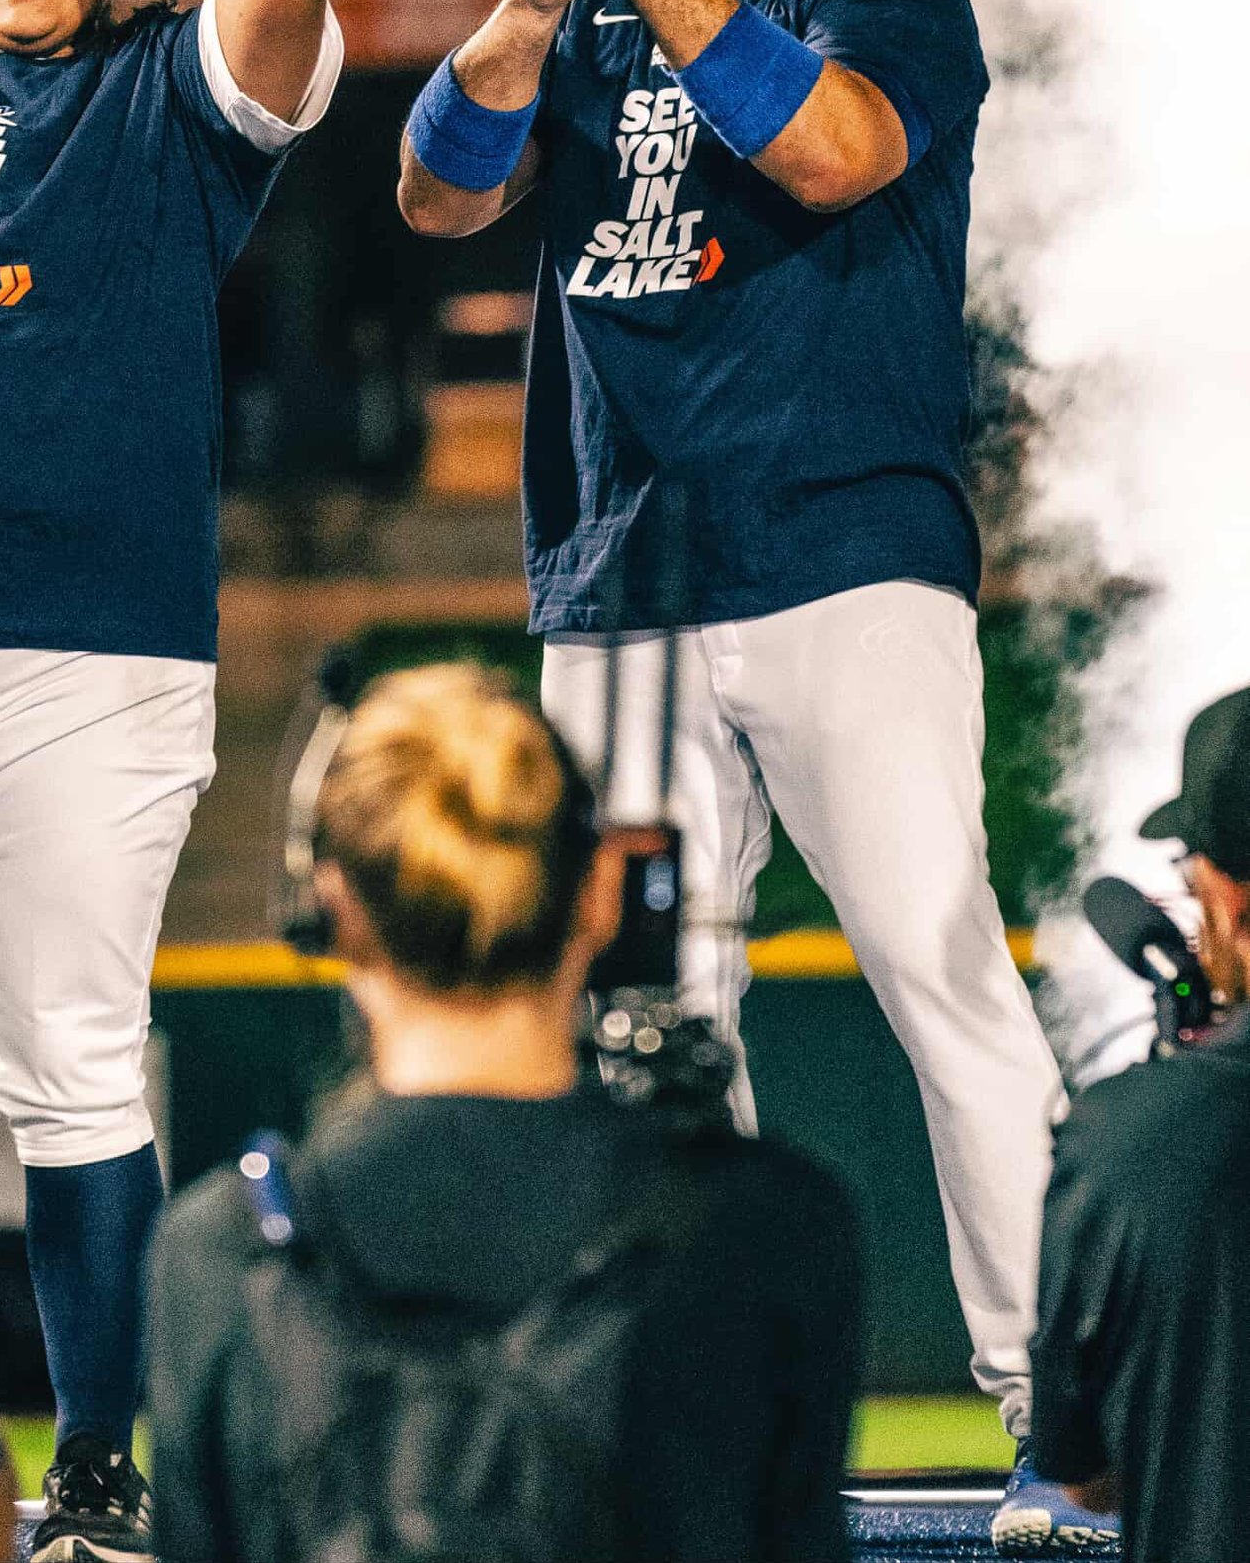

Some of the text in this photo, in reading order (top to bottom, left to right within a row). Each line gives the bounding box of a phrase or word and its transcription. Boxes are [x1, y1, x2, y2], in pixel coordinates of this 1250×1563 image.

[618, 87, 698, 133] SEE
[615, 123, 698, 179] YOU
[626, 173, 682, 221] IN
[583, 210, 704, 261] SALT
[565, 248, 703, 300] LAKE
